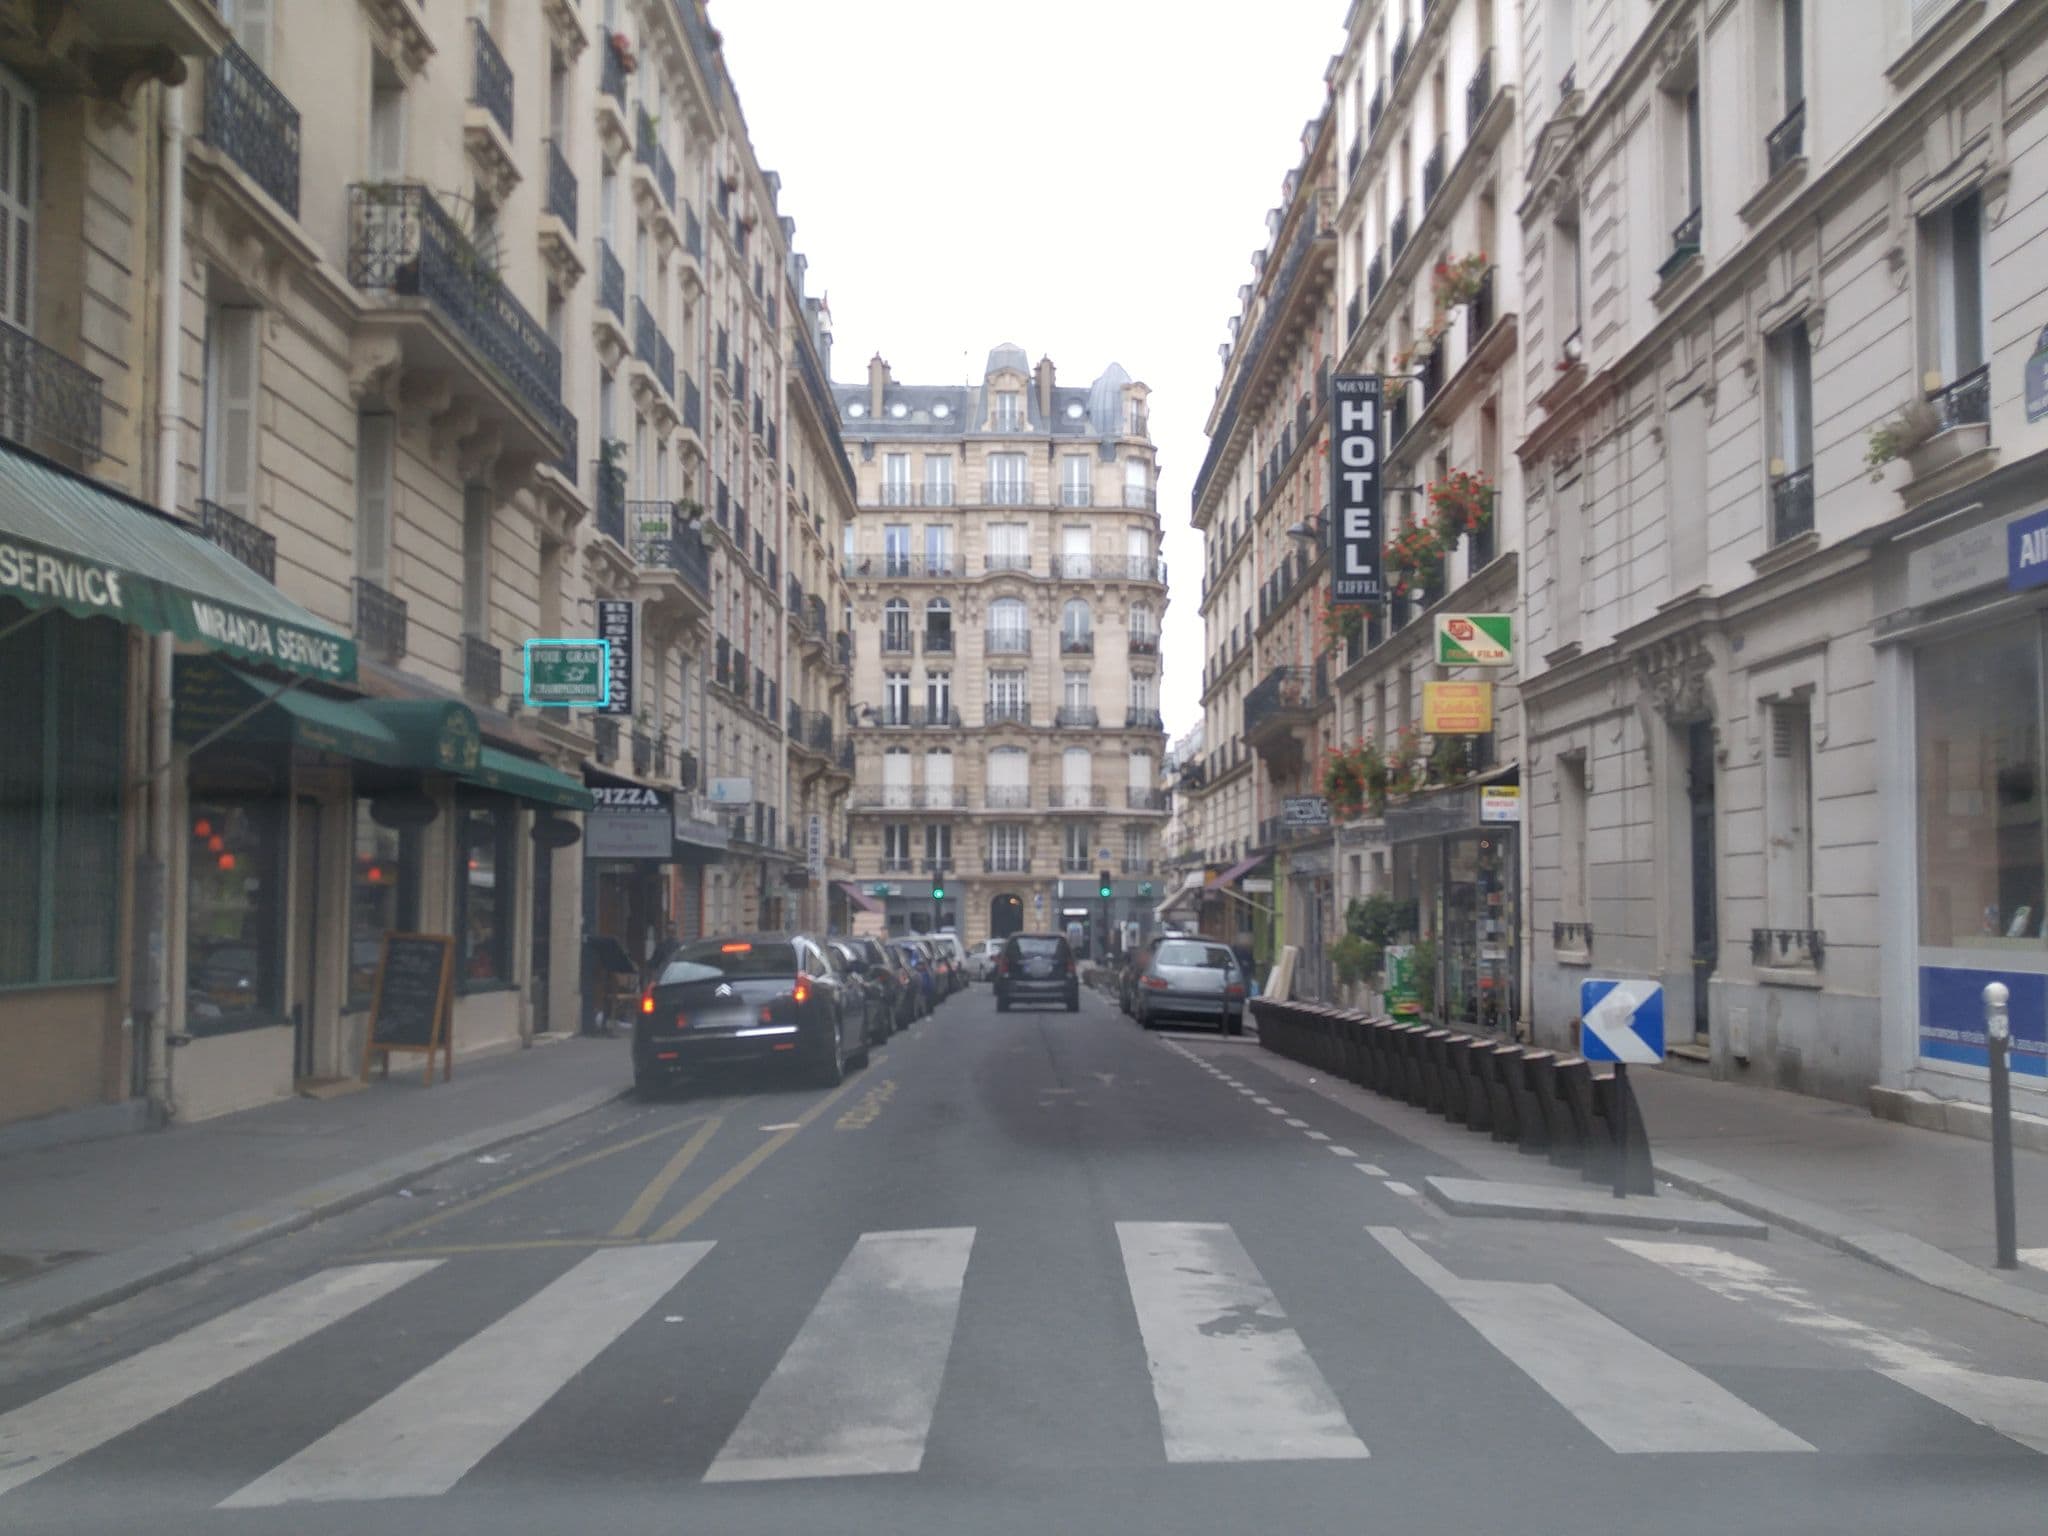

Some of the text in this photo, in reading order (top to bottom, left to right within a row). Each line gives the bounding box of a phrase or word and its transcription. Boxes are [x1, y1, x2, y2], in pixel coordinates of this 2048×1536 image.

[1341, 400, 1375, 575] HOTEL
[0, 544, 123, 608] SERVICE
[1337, 580, 1379, 594] EIFFEL
[191, 600, 341, 673] MIRANDA SERVICE
[565, 650, 598, 664] GRAS
[1478, 649, 1504, 658] FILM
[604, 603, 628, 712] RESTAURANT
[590, 787, 660, 805] PIZZA
